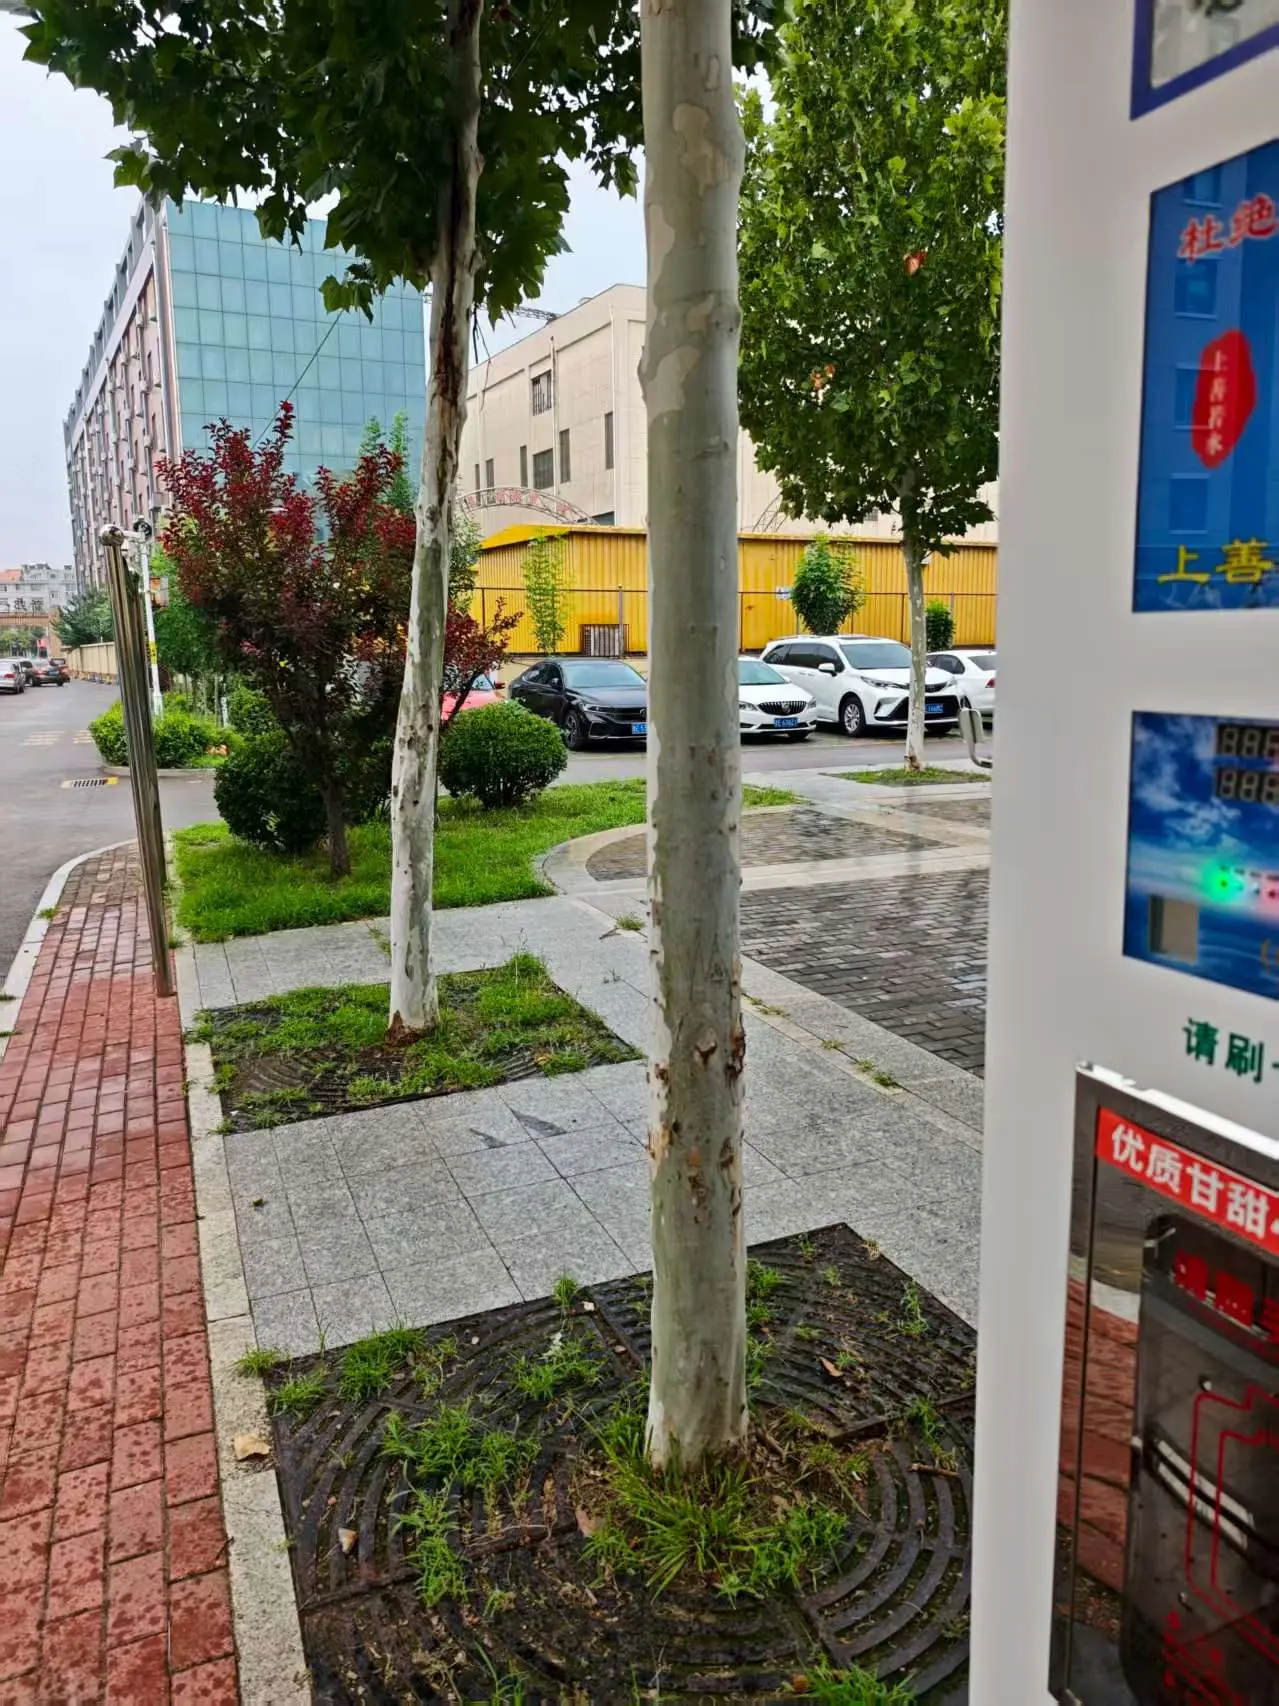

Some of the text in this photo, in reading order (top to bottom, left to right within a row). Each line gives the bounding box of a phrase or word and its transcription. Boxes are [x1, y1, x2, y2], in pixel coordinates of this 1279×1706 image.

[1178, 193, 1278, 265] 杜绝
[1158, 538, 1273, 585] 上善
[1182, 1016, 1279, 1084] 请刷
[1112, 1124, 1279, 1239] 优质甘甜
